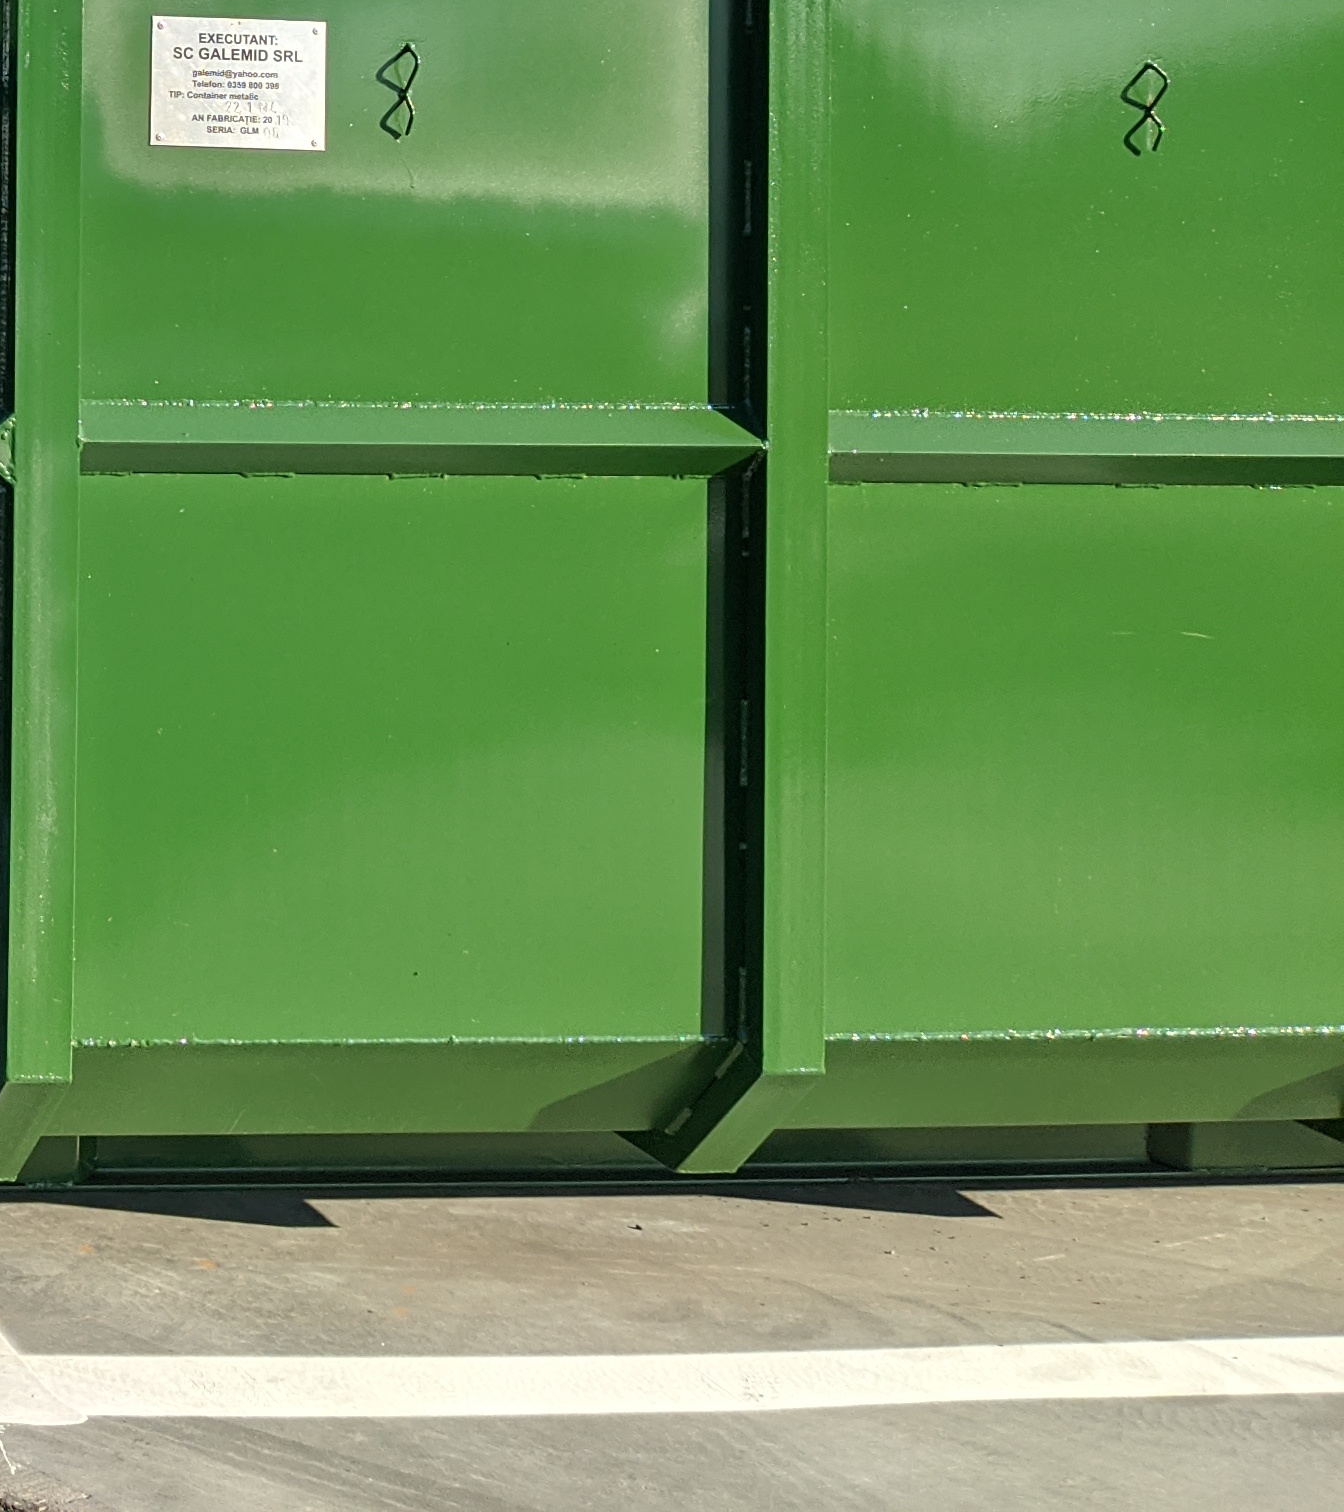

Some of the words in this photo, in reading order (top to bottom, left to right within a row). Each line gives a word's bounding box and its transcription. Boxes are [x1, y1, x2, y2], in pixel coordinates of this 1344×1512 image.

[198, 32, 279, 46] EXECUTANT:
[172, 46, 194, 60] SC
[198, 47, 269, 62] GALEMID
[272, 49, 304, 63] SRL
[192, 69, 279, 79] galemid@yahoo.com
[192, 79, 225, 89] Telefon:
[227, 81, 247, 90] 0359
[168, 90, 185, 99] TIP:
[186, 90, 227, 100] Container
[228, 92, 259, 101] metalic
[191, 114, 205, 123] AN
[206, 126, 236, 134] SERIA:
[239, 126, 260, 135] GLM
